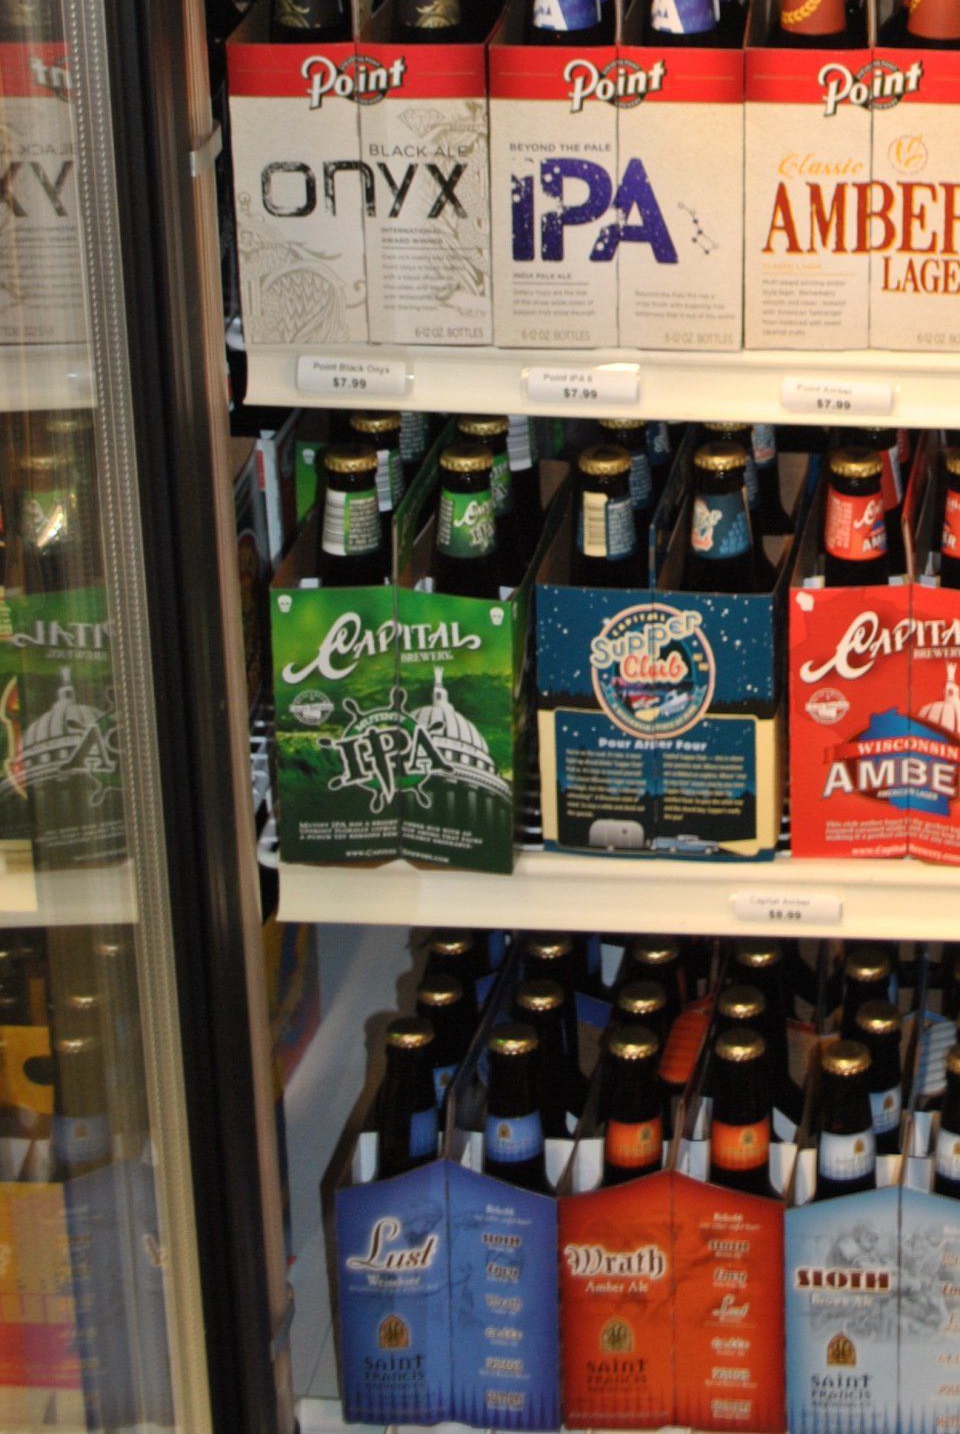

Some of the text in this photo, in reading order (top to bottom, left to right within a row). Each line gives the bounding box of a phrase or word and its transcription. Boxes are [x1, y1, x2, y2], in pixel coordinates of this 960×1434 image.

[301, 55, 407, 111] Point
[563, 58, 669, 113] Point
[818, 60, 924, 116] Point
[369, 143, 428, 158] BLACK
[509, 142, 612, 153] BEYOND THE PALE
[333, 377, 367, 389] $7.99
[563, 388, 598, 400] $7.99
[816, 398, 851, 410] $7.99
[282, 611, 482, 685] CAPITAL
[857, 736, 959, 760] WISCONSIN
[335, 724, 455, 806] IPA
[347, 1216, 438, 1274] Lust
[564, 1242, 668, 1281] Wrath
[585, 1279, 649, 1293] Amber Ale
